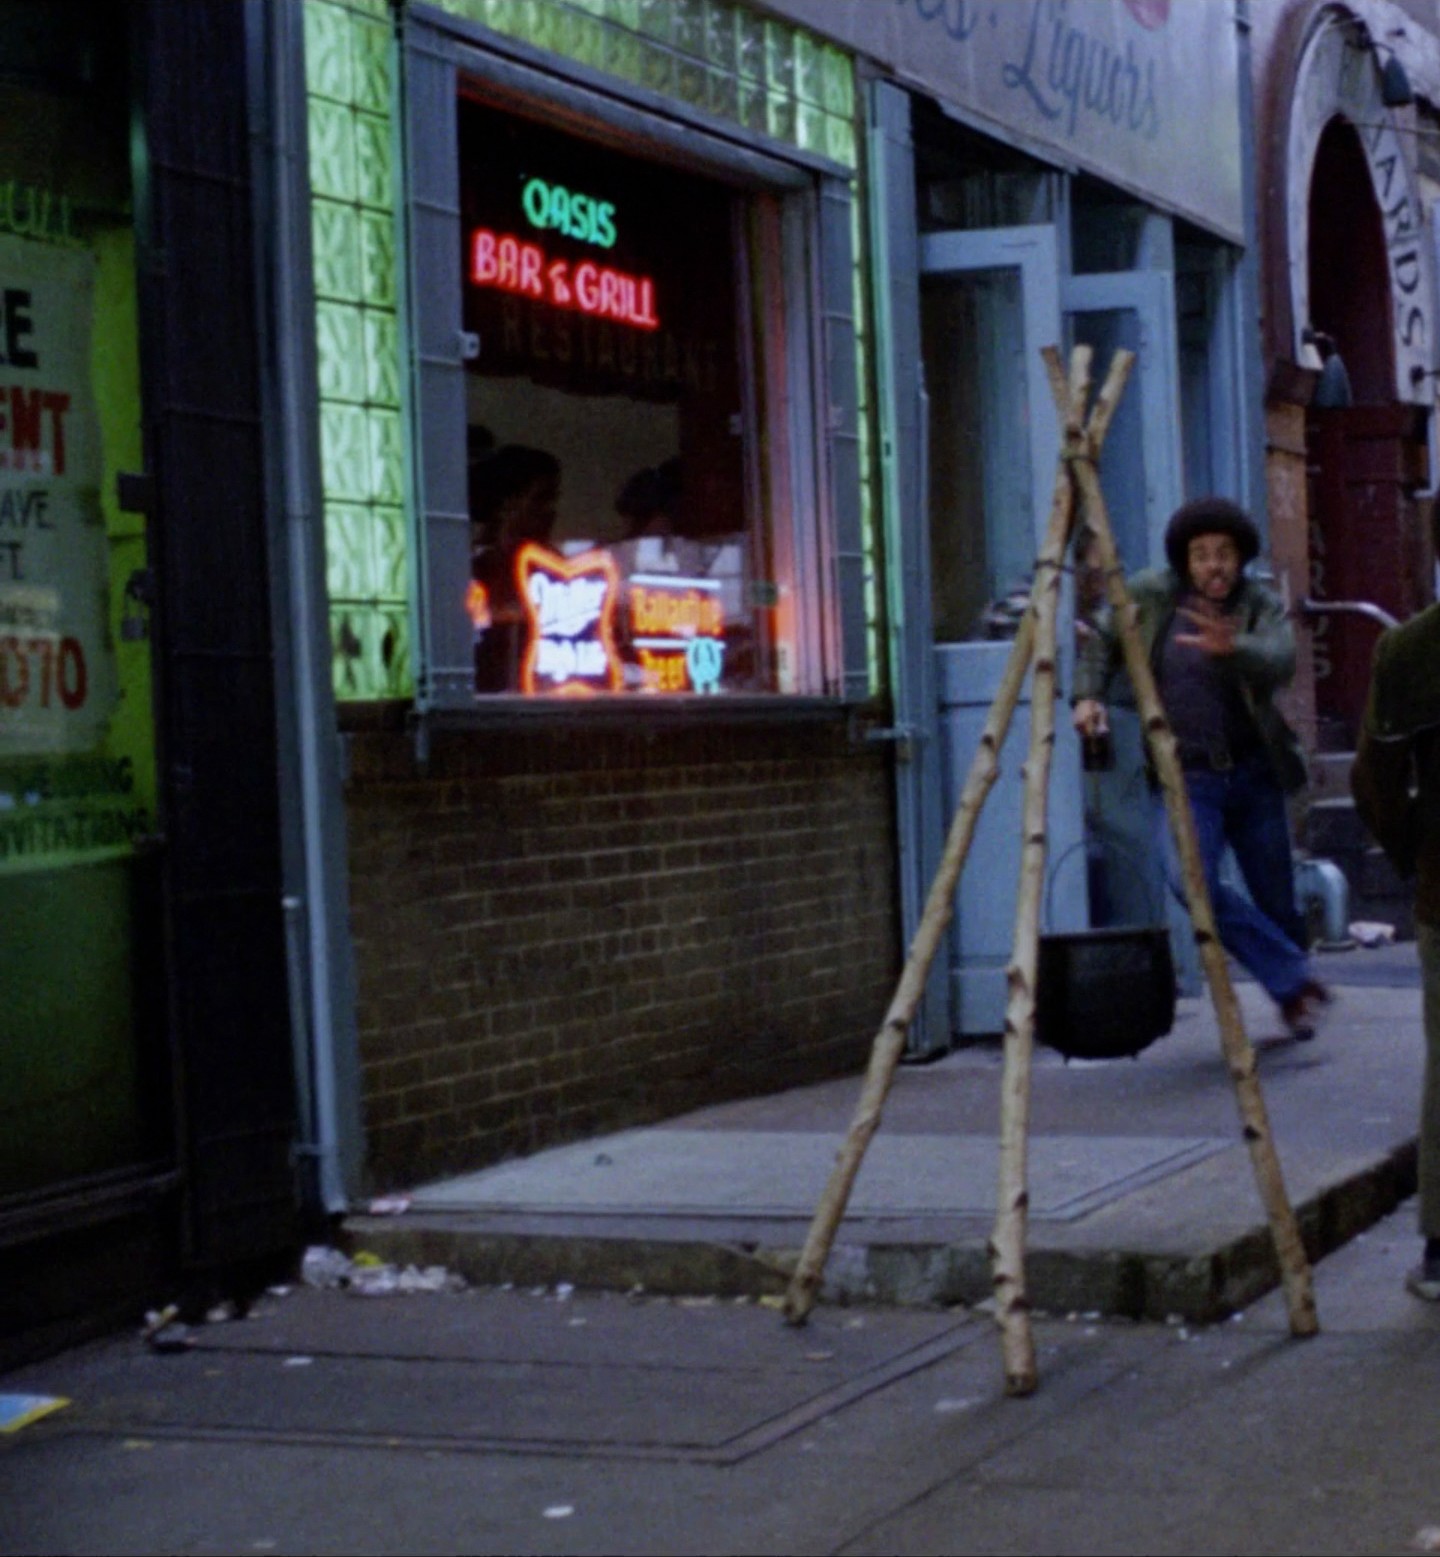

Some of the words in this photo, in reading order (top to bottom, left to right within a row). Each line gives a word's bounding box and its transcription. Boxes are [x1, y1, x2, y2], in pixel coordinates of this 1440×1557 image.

[1002, 0, 1164, 141] Liquors
[522, 178, 618, 248] OASIS
[473, 230, 543, 297] BAR
[574, 262, 659, 328] GRILL
